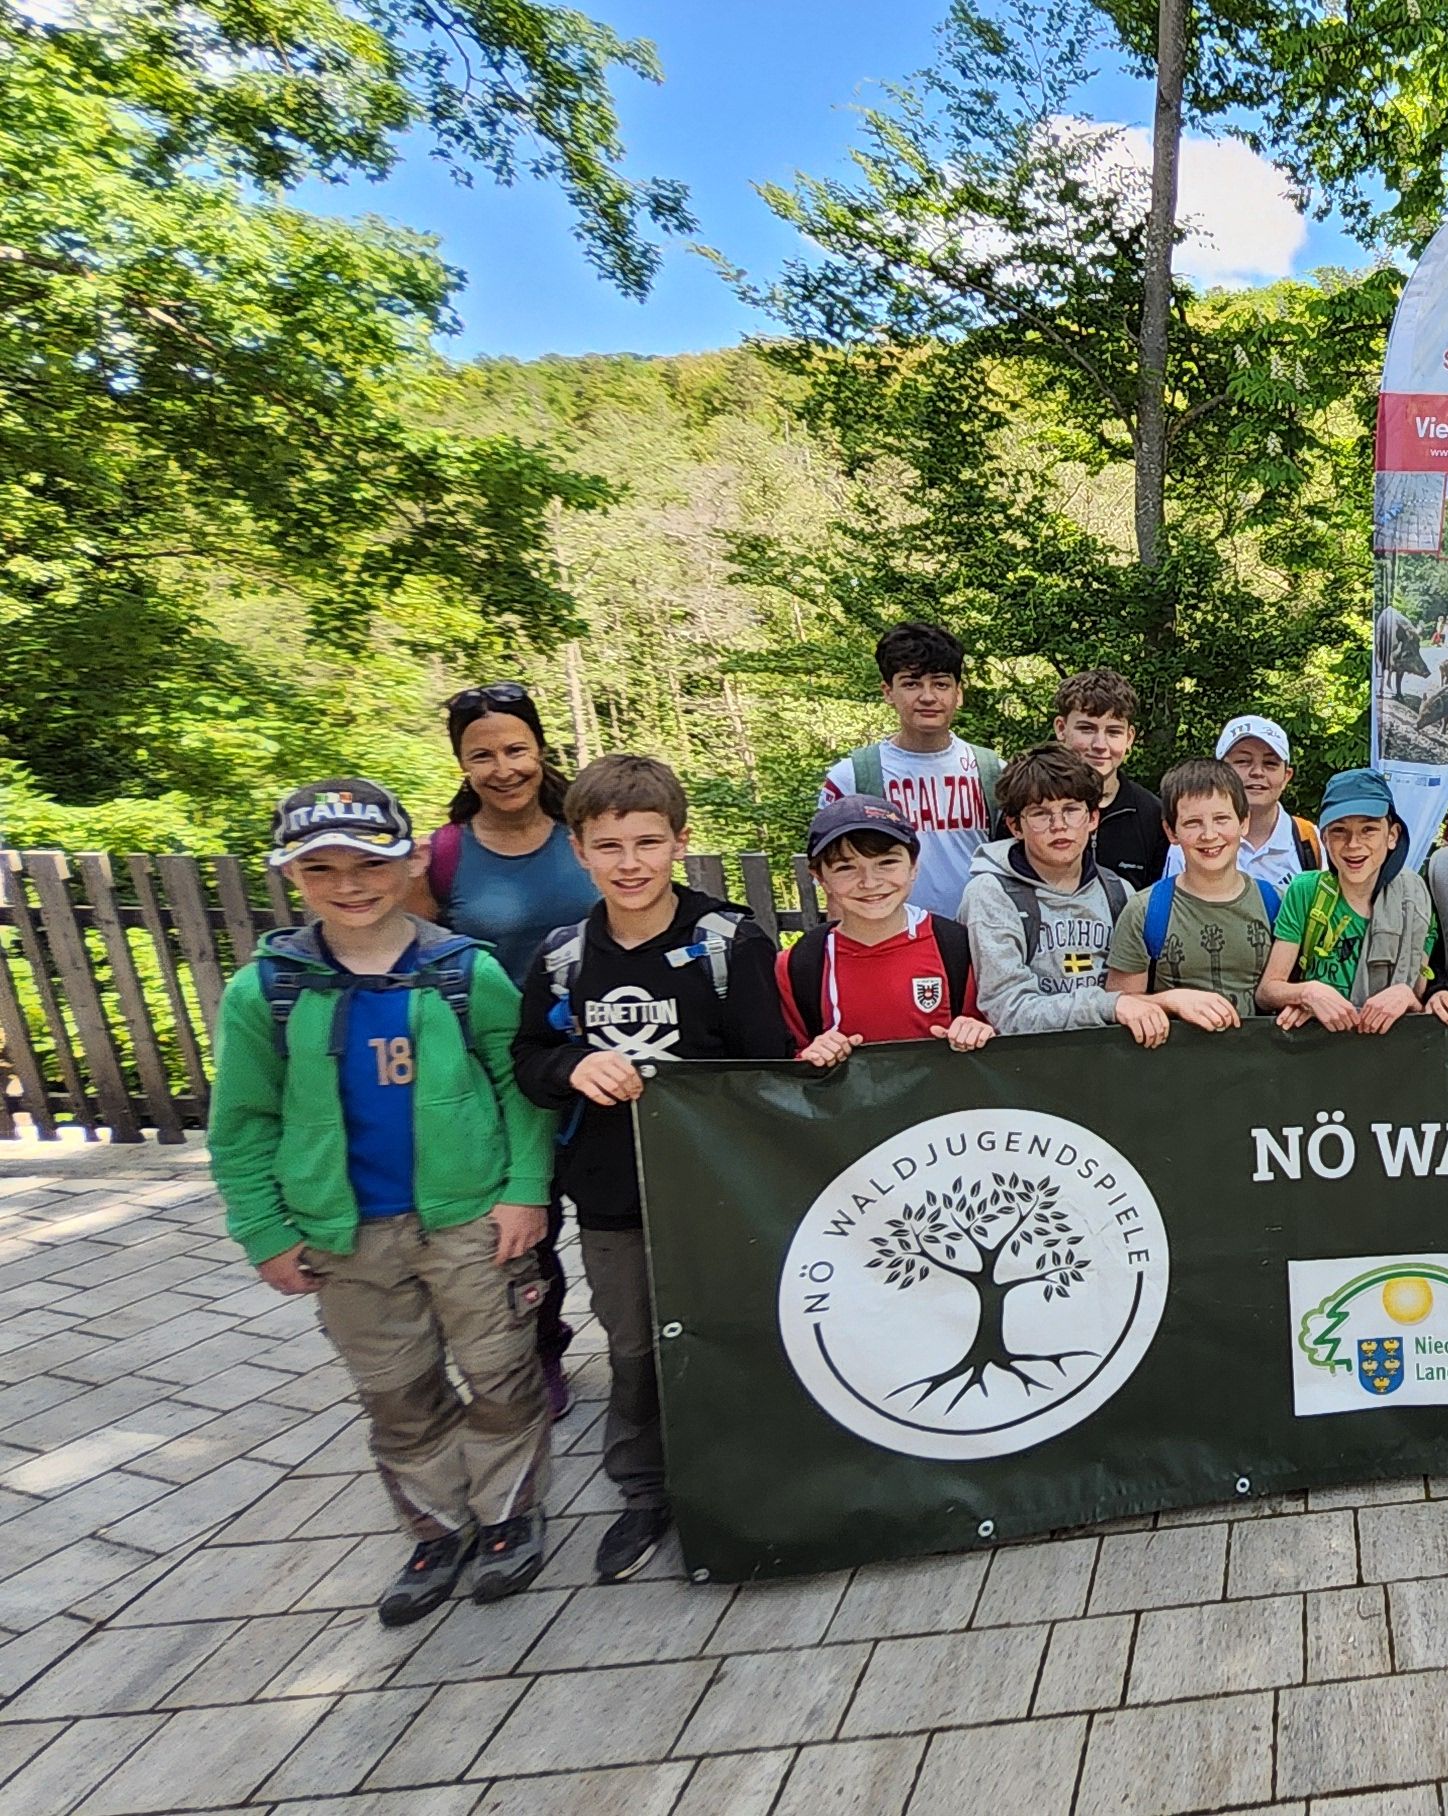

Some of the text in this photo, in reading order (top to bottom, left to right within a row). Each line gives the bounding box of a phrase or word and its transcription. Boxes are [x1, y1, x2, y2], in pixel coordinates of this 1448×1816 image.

[288, 802, 387, 831] ITALIA
[883, 775, 991, 832] SCALZON
[585, 998, 677, 1027] BENETTON
[368, 1037, 414, 1086] 18
[1250, 1110, 1356, 1182] NÖ
[799, 1131, 1150, 1314] NÖ WALDJUGENDSPIELE
